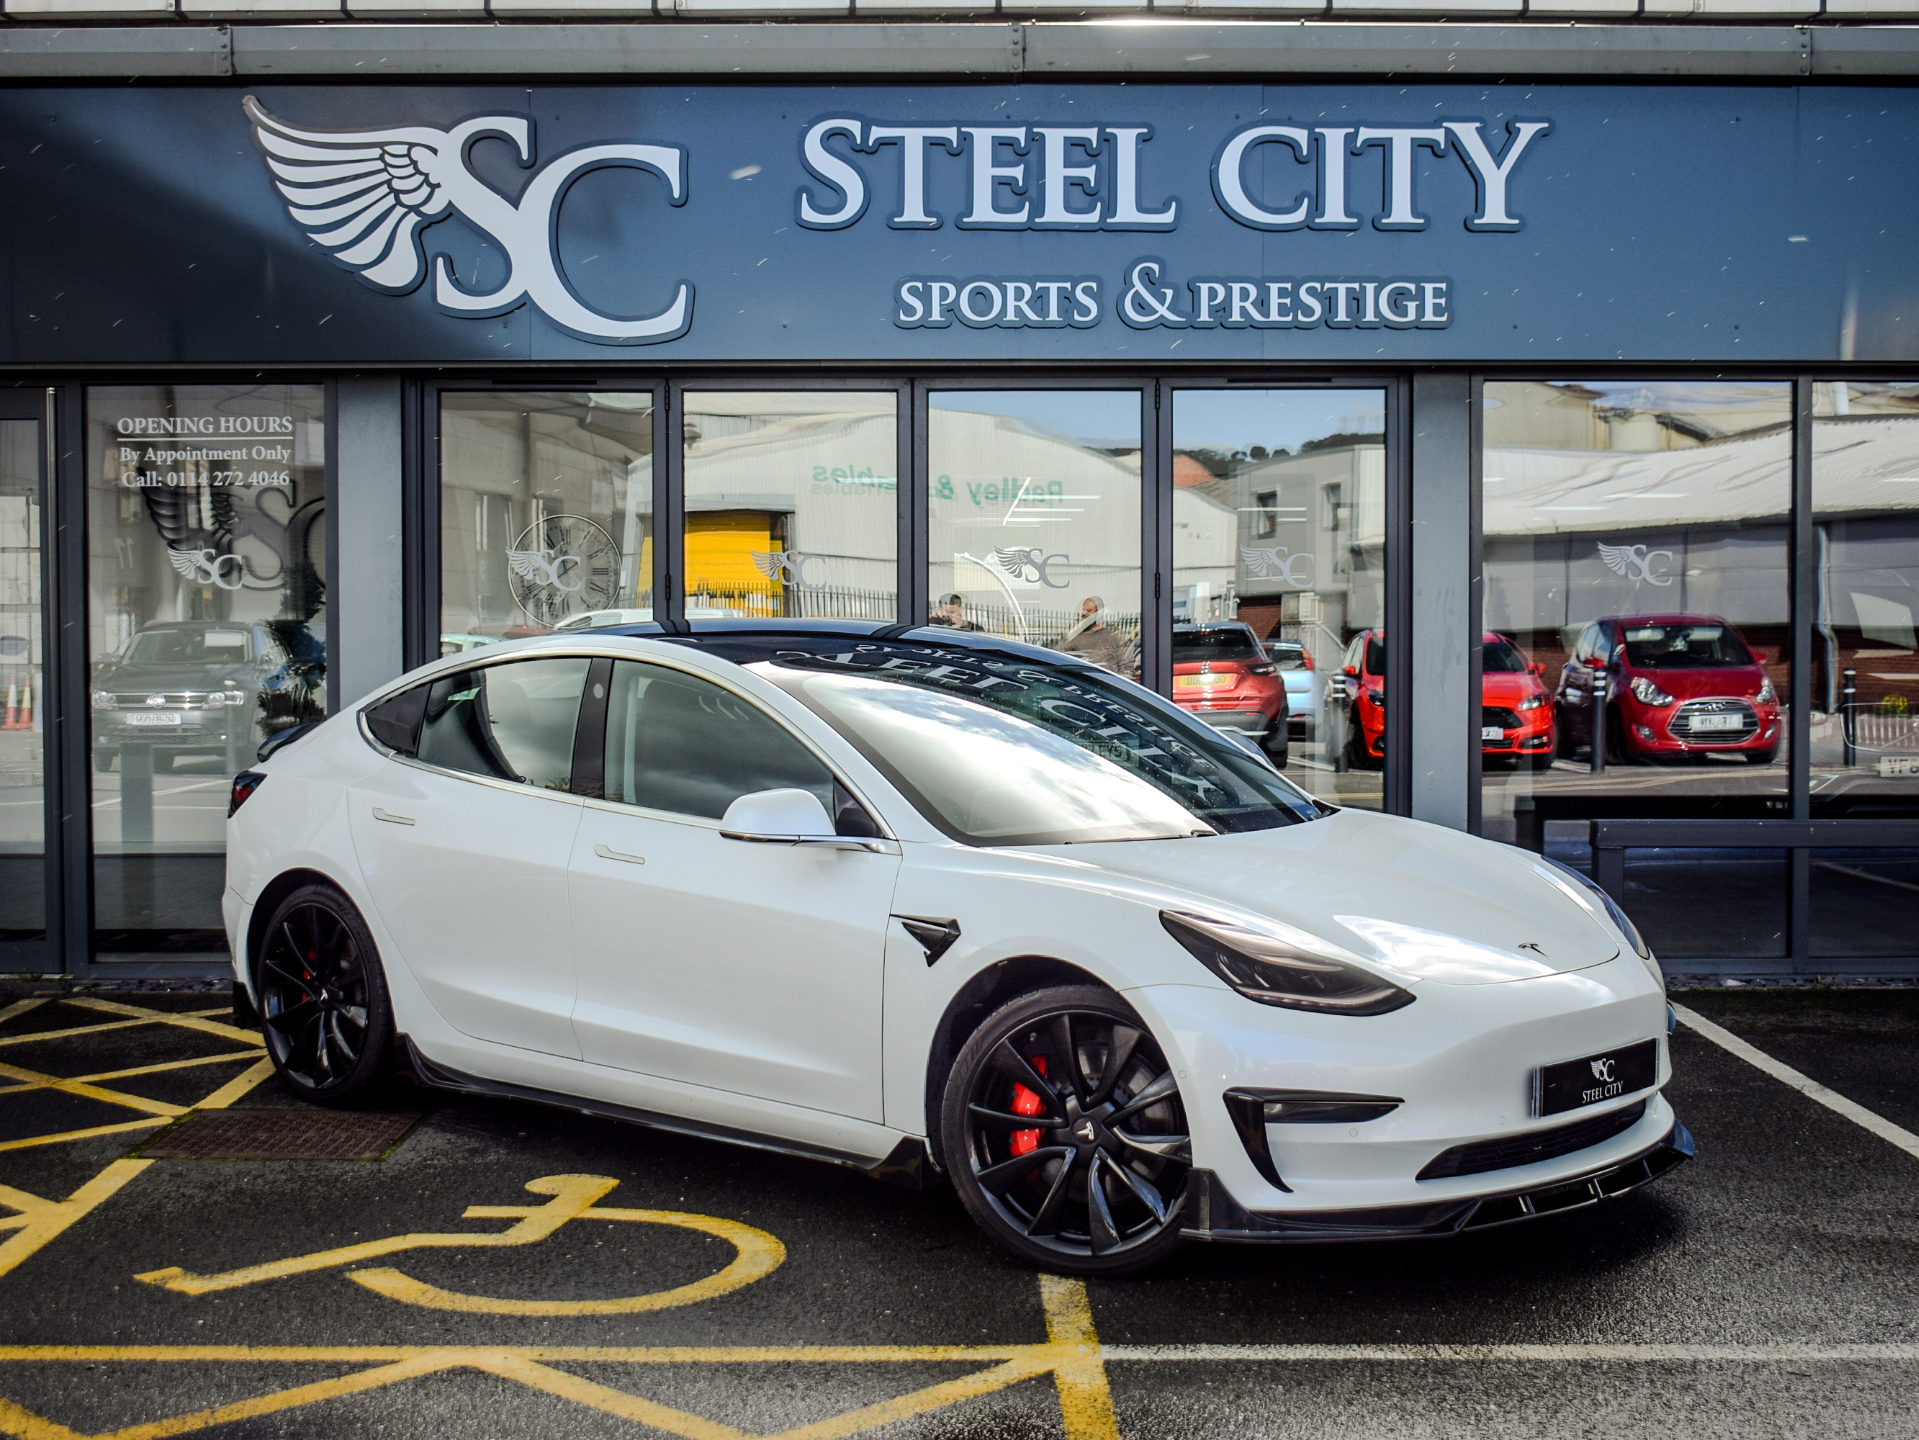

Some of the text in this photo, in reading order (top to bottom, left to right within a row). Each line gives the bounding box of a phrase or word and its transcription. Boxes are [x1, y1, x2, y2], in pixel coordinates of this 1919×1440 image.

[800, 118, 1549, 225] STEEL CITY
[436, 116, 687, 338] SC
[900, 262, 1448, 322] SPORTS & PRESTIGE
[117, 416, 293, 434] OPENING HOURS
[120, 445, 291, 466] By Appointment Only
[122, 470, 290, 487] Call: 0114 272 4046
[198, 548, 243, 590] SC
[536, 549, 581, 591] SC
[782, 550, 827, 591] SC
[1024, 548, 1070, 589] SC
[1269, 546, 1314, 588] SC
[1628, 544, 1673, 586] SC
[1600, 1058, 1615, 1081] SC
[1582, 1080, 1624, 1104] STEEL CITY
